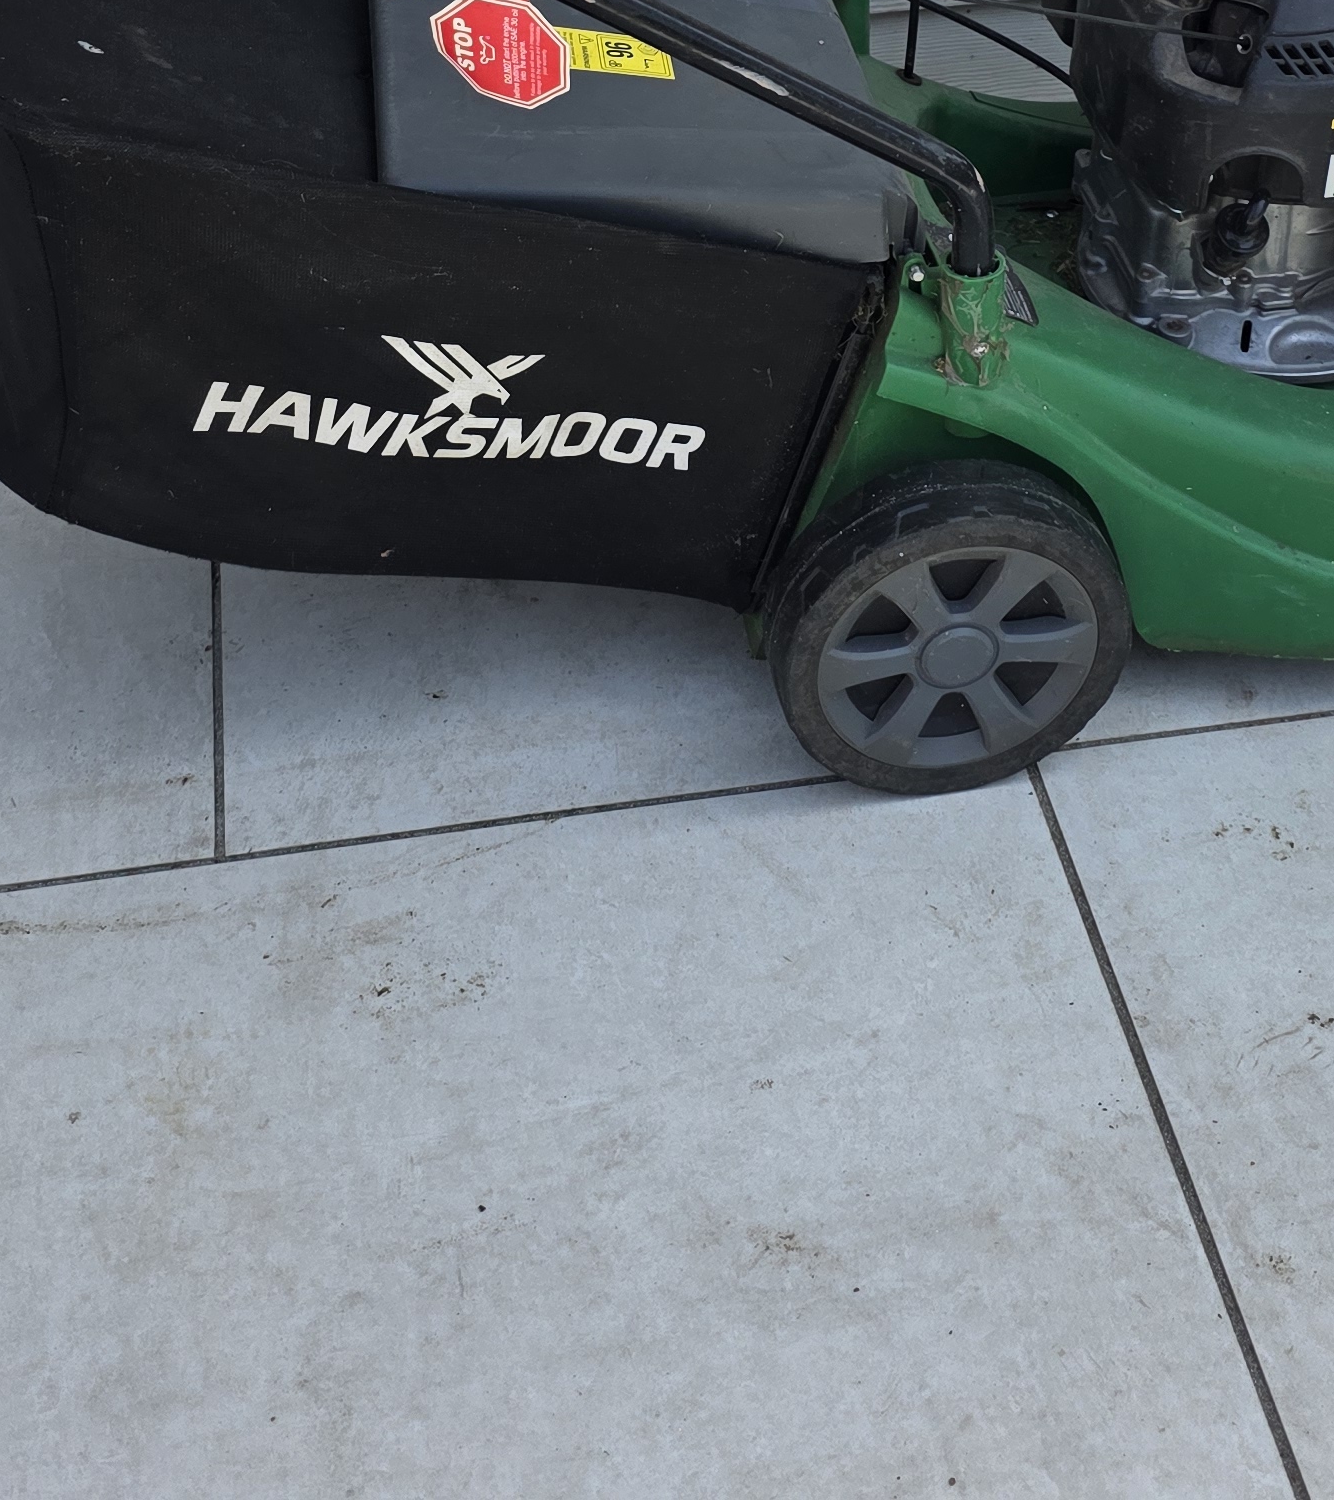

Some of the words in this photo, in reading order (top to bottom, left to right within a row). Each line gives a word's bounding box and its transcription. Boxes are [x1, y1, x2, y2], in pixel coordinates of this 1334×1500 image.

[503, 16, 511, 37] engine
[511, 18, 519, 27] 30
[452, 17, 476, 72] STOP
[605, 41, 634, 58] 96
[503, 59, 512, 73] NOT
[512, 64, 521, 82] putting
[504, 73, 512, 85] DO
[192, 380, 707, 472] HAWKSMOOR
